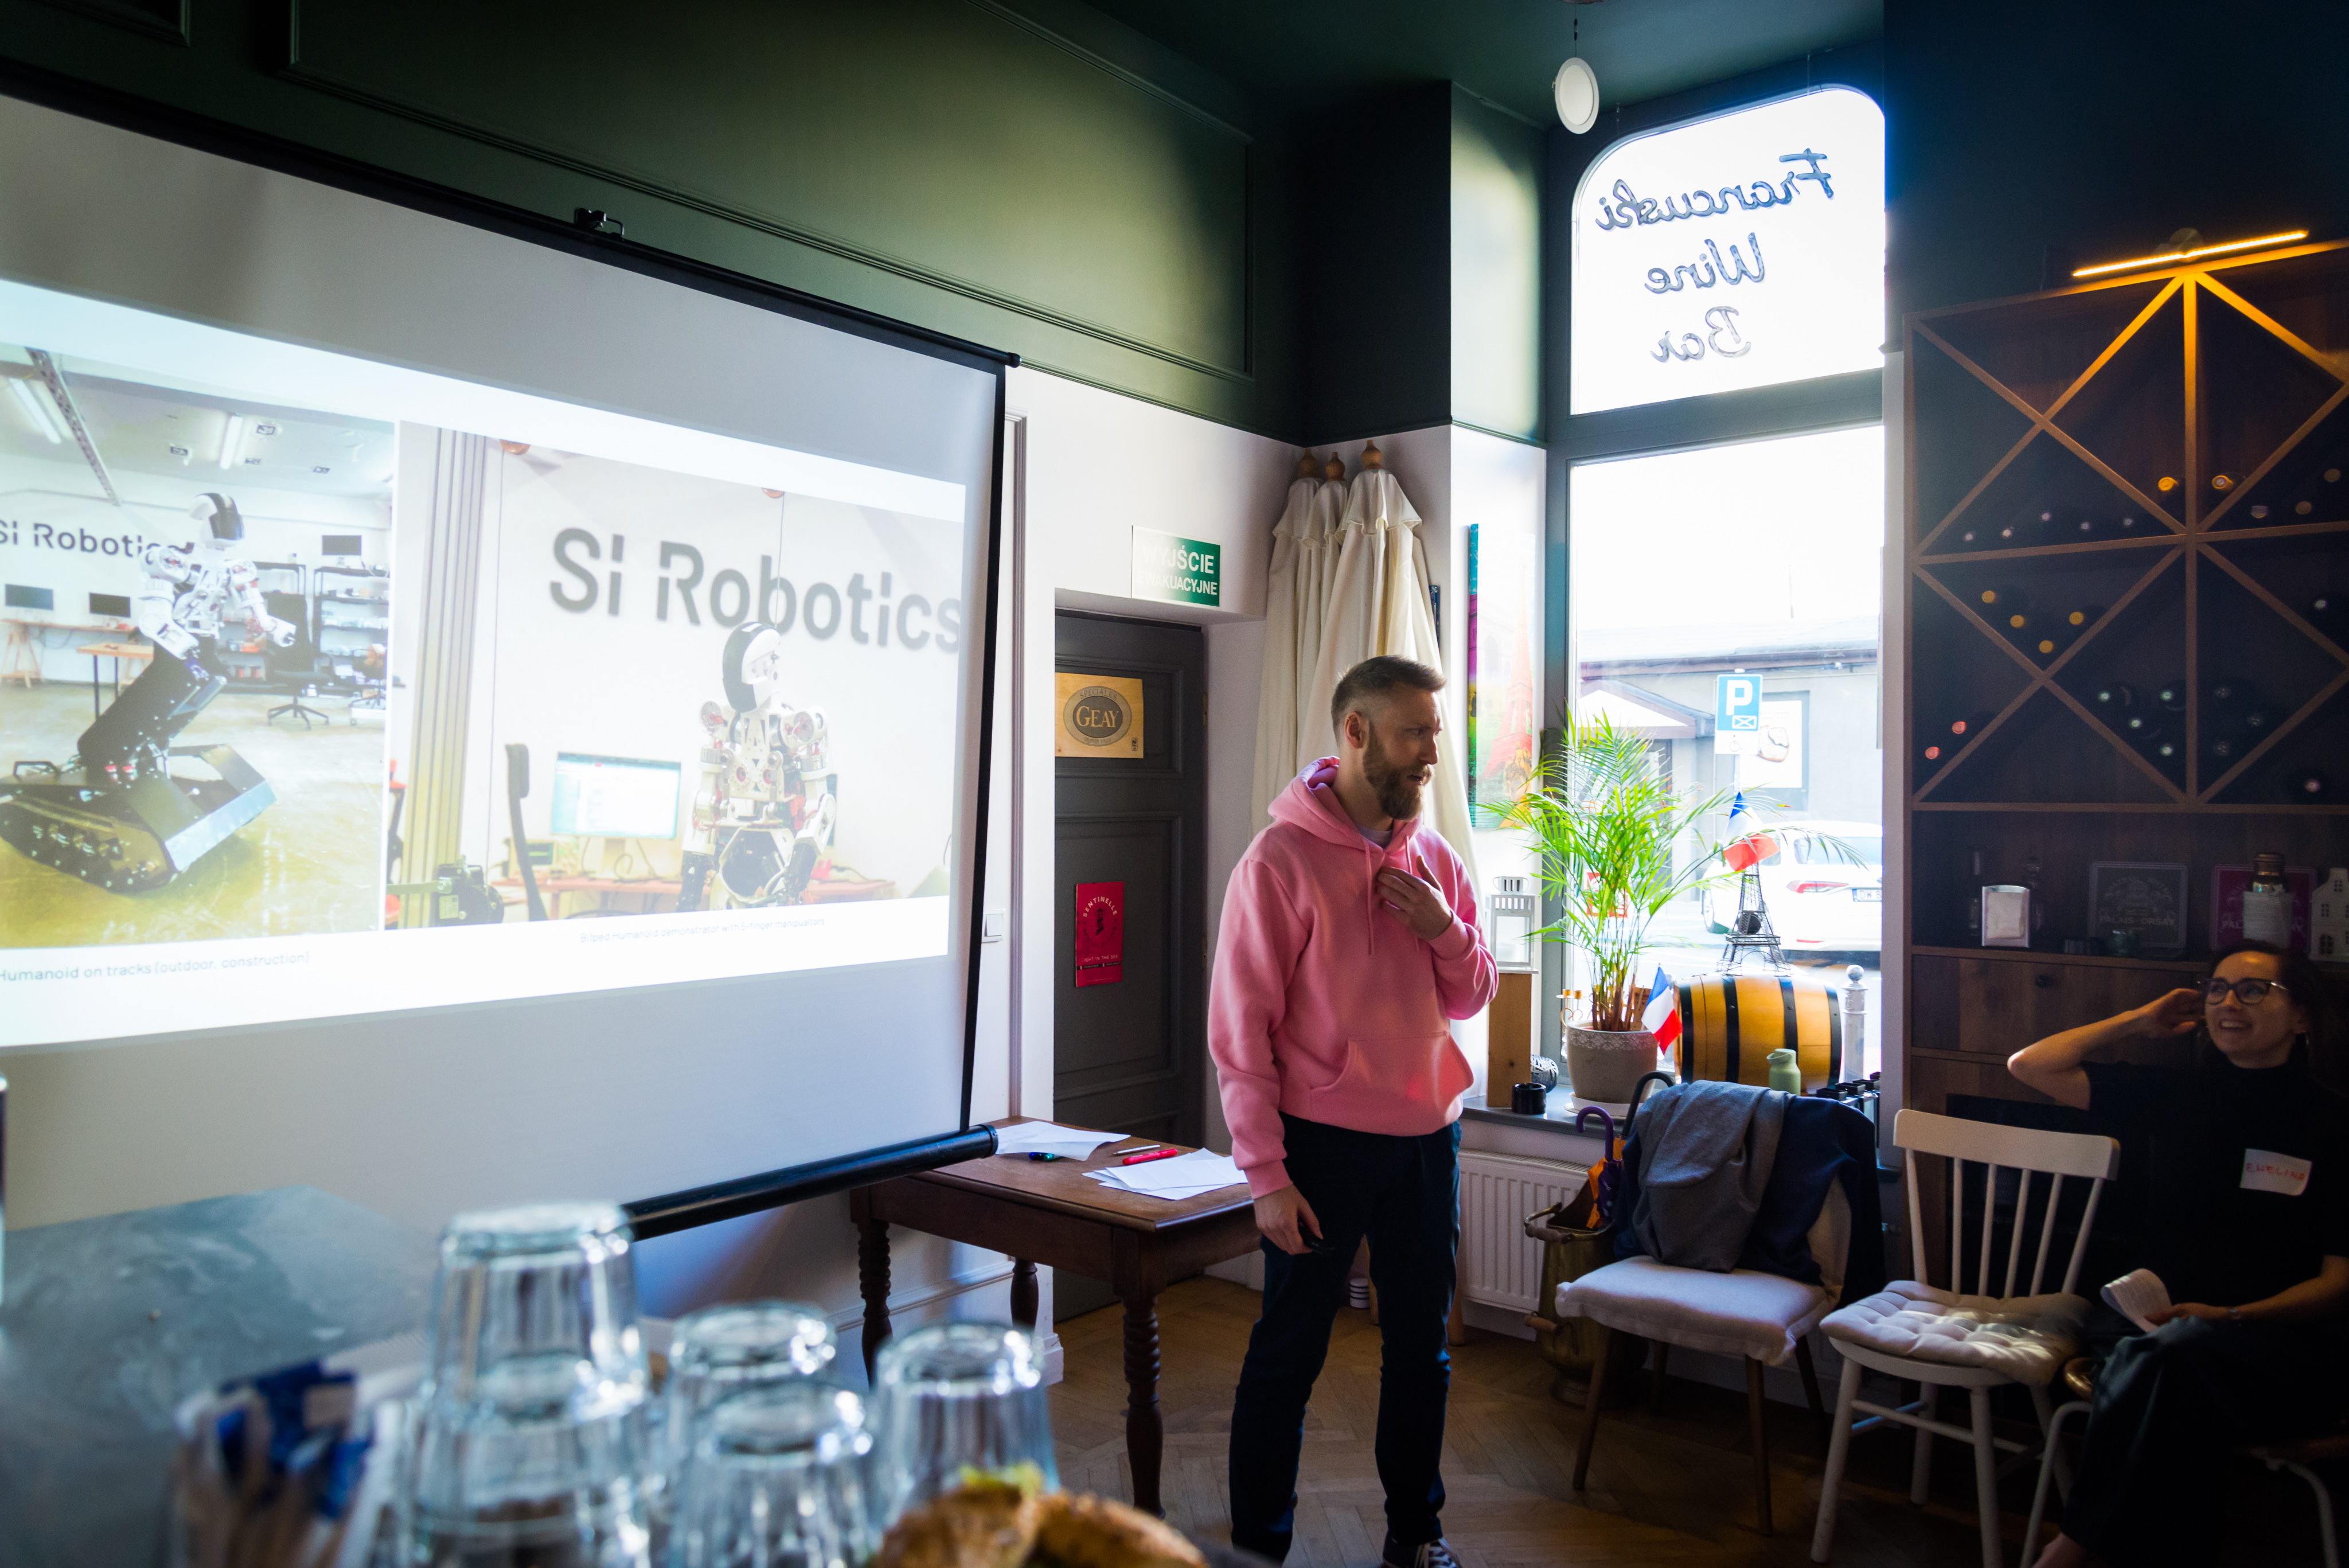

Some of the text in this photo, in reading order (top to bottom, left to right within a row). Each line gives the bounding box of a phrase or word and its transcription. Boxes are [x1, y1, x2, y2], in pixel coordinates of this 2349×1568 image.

[549, 527, 962, 654] Si Robotics
[1726, 680, 1753, 716] P
[1076, 705, 1119, 728] GEAY
[1859, 890, 1872, 899] DW
[1083, 896, 1118, 918] SENTINELLE
[612, 929, 658, 939] Humanoid
[661, 926, 719, 937] demonstrator
[721, 923, 739, 931] with
[741, 921, 773, 931] 5-finger
[84, 968, 102, 978] on
[107, 963, 151, 976] tracks
[221, 951, 309, 968] construction)
